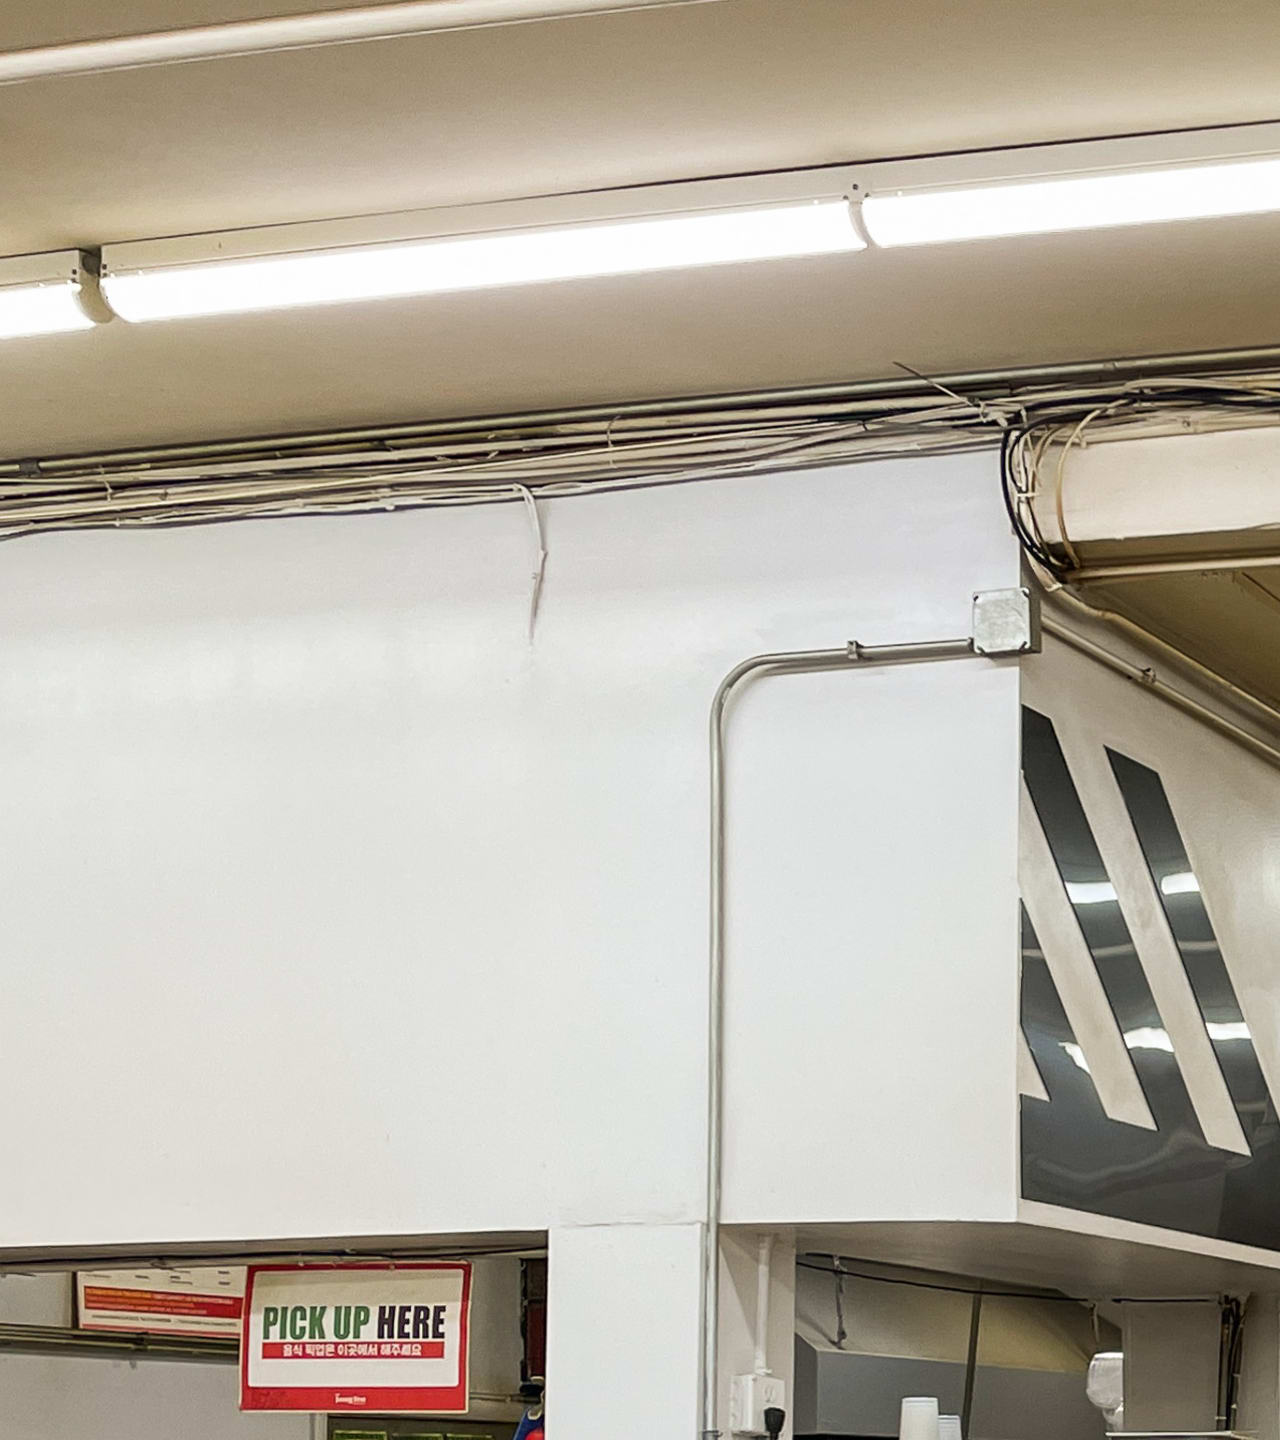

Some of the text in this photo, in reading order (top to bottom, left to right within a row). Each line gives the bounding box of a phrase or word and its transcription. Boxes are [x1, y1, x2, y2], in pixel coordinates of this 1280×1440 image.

[262, 1305, 446, 1340] PICK UP HERE
[381, 1343, 422, 1357] 해주세요
